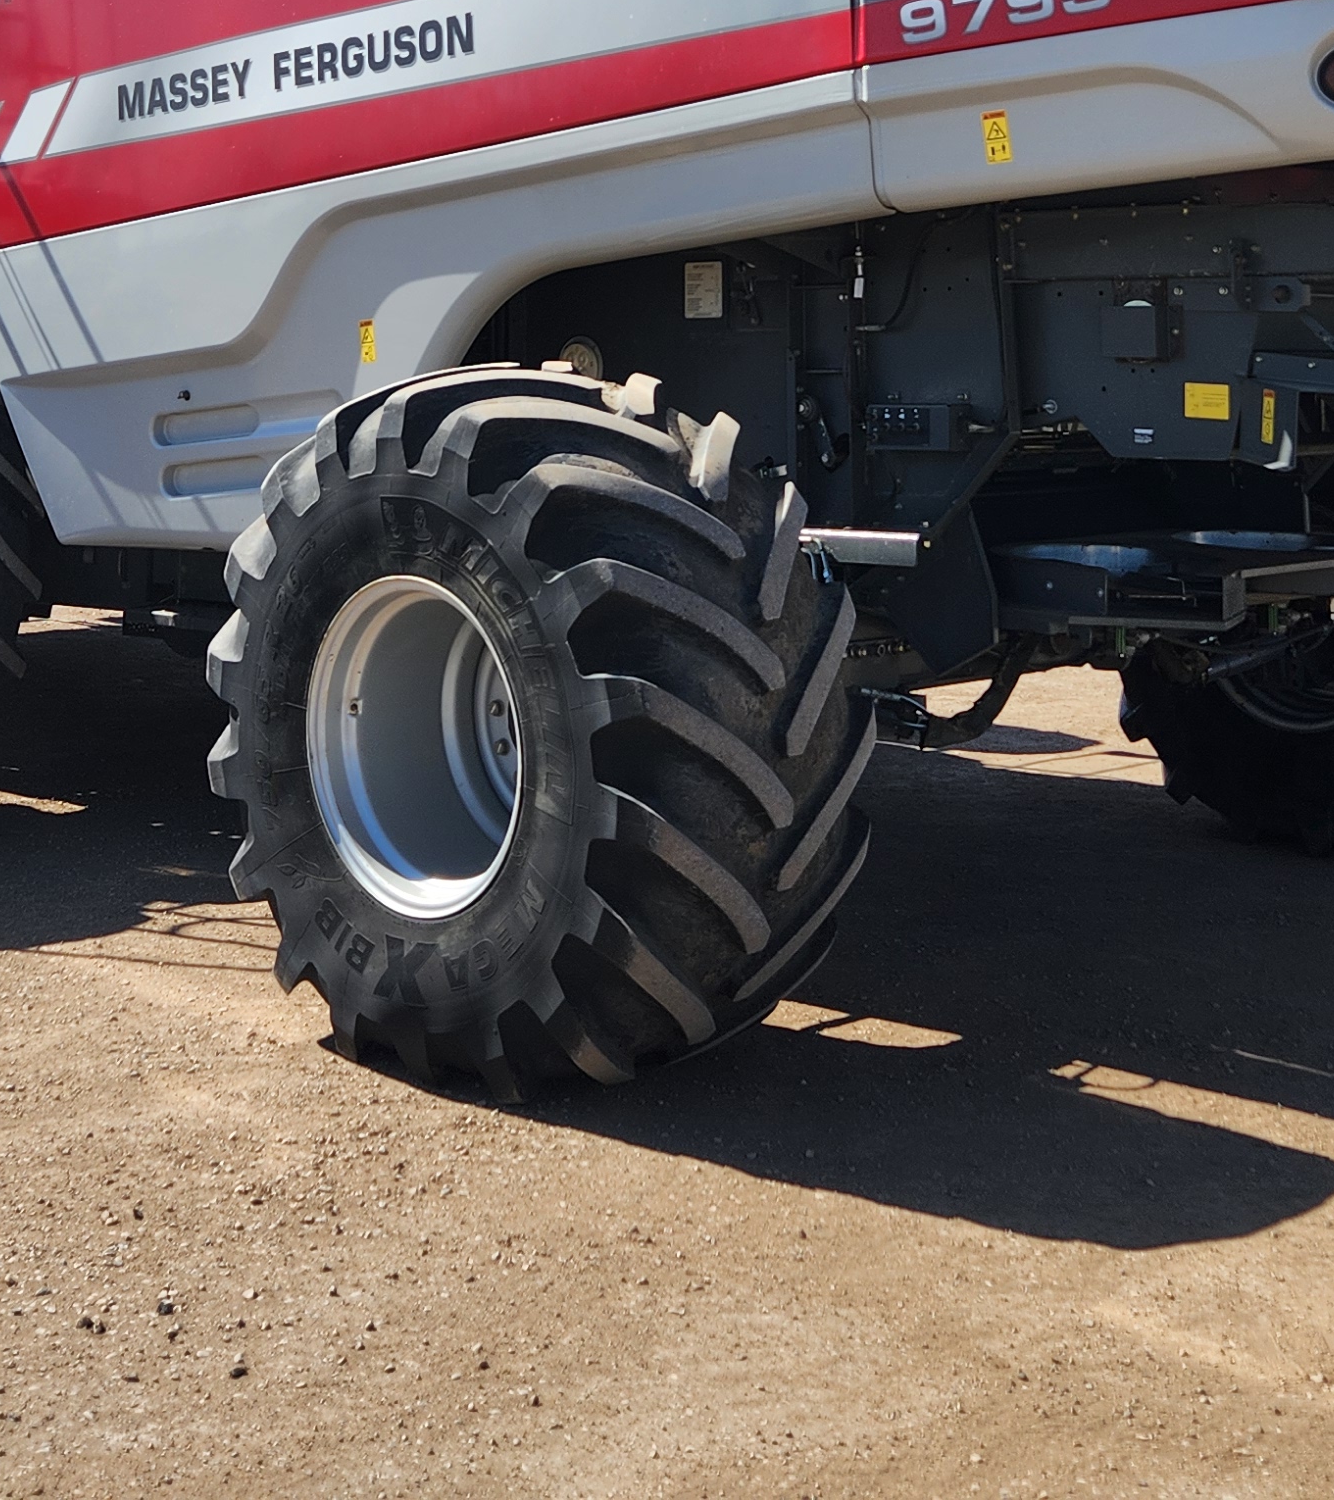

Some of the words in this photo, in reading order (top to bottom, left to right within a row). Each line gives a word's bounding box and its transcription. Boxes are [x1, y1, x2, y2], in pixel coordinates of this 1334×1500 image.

[117, 57, 252, 121] MASSEY
[273, 12, 475, 90] FERGUSON
[440, 521, 570, 797] MICHELIN
